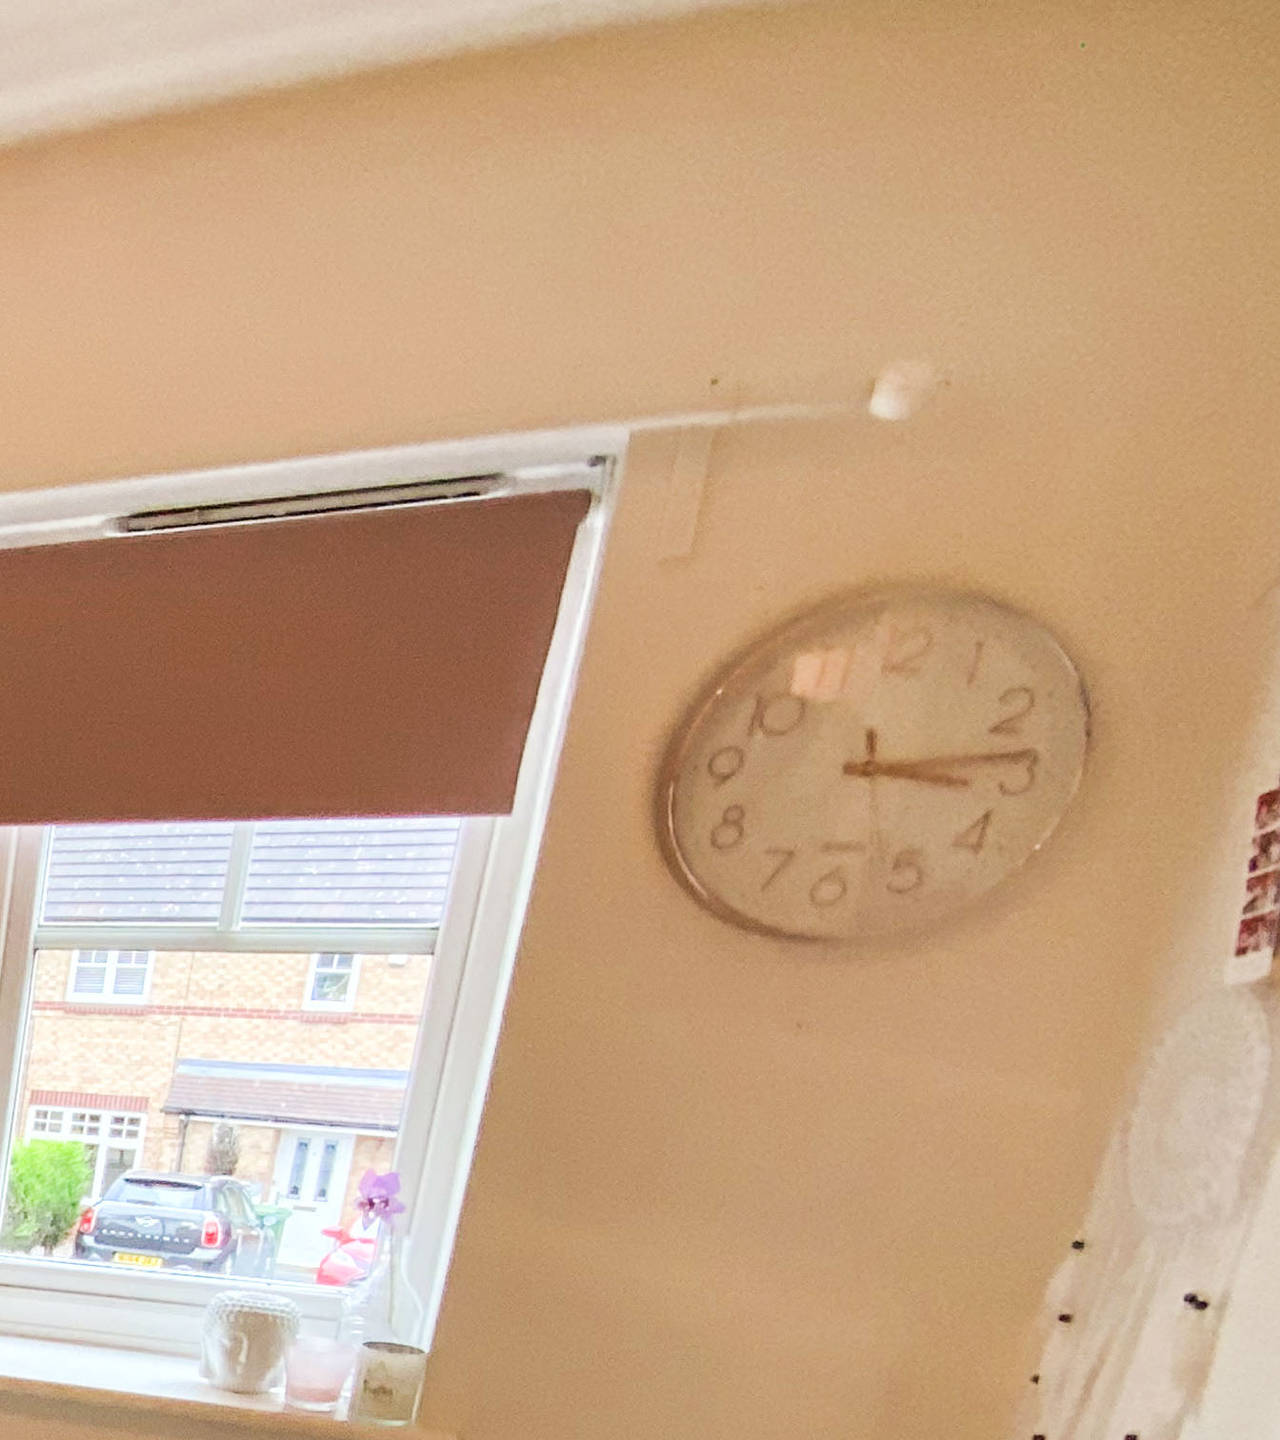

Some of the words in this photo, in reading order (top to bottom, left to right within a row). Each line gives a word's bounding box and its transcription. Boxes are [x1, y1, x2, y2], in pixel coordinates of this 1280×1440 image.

[880, 624, 934, 677] 12
[966, 639, 985, 687] 1
[747, 692, 806, 738] 10
[989, 686, 1036, 736] 2
[707, 744, 745, 787] 9
[998, 747, 1039, 797] 3
[710, 804, 745, 851] 8
[951, 808, 993, 855] 4
[761, 847, 796, 892] 7
[809, 864, 848, 908] 6
[886, 848, 924, 895] 5
